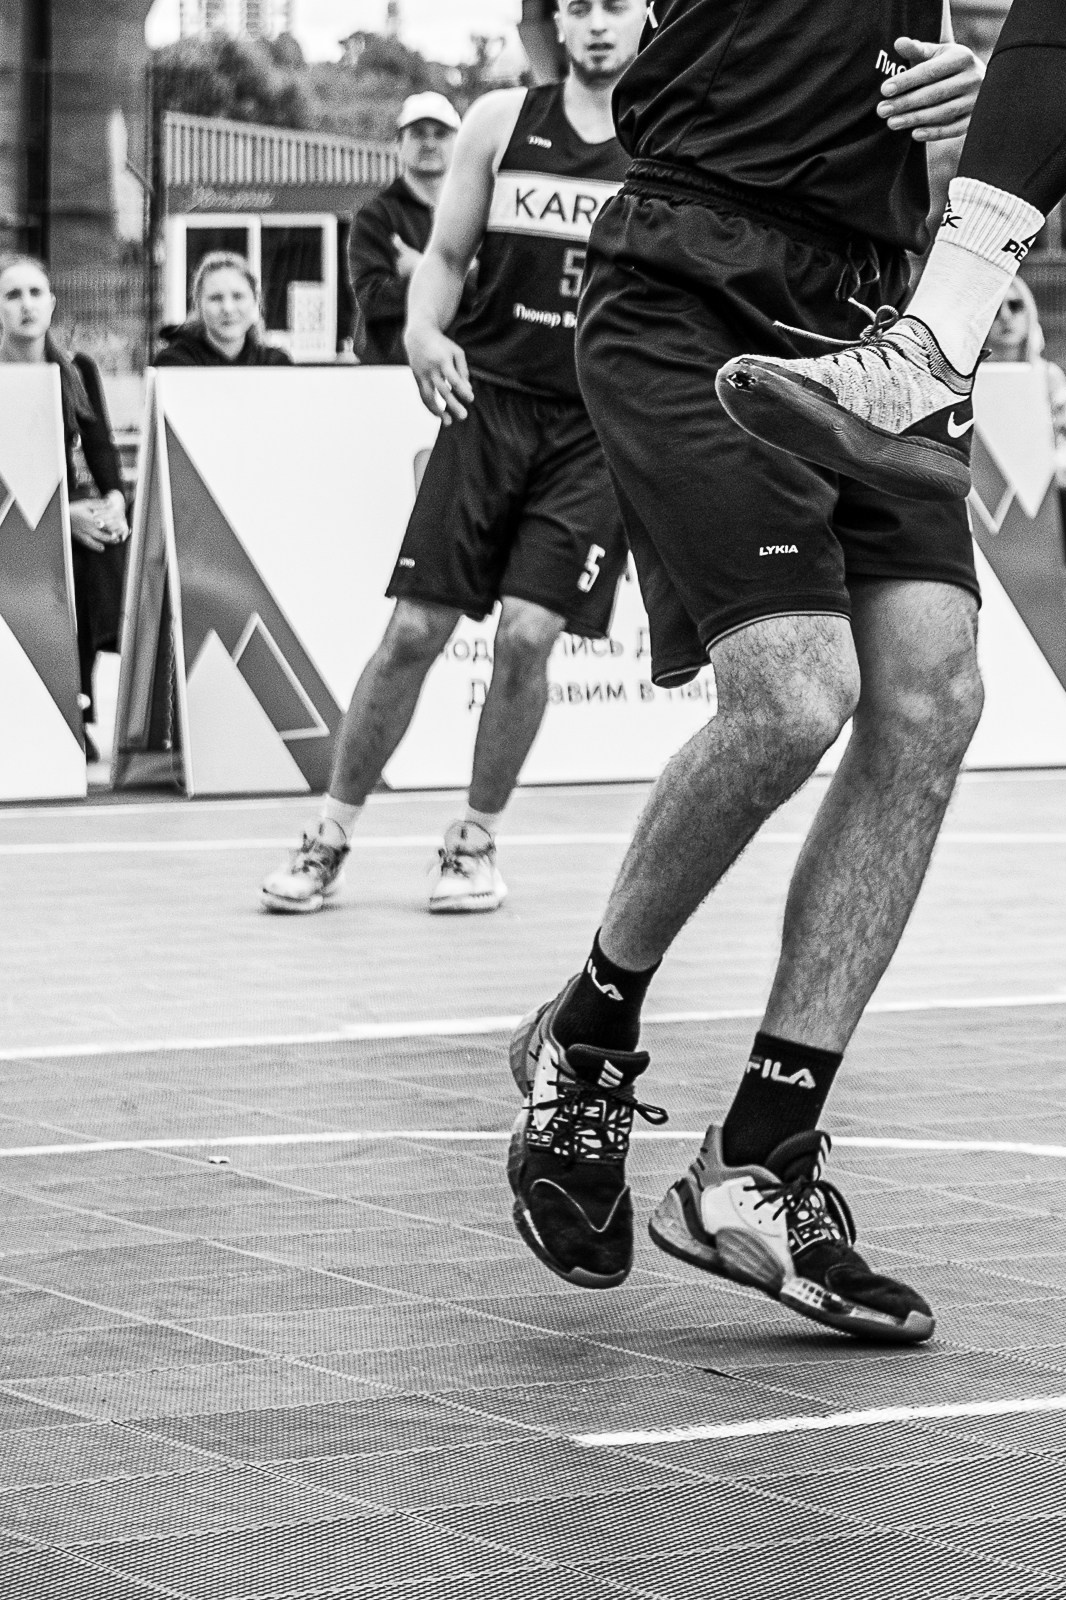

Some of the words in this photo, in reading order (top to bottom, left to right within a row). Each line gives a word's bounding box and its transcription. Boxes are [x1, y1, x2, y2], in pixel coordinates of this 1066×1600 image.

[759, 544, 799, 556] LYKIA
[577, 543, 606, 593] 5
[747, 1054, 816, 1089] FILA
